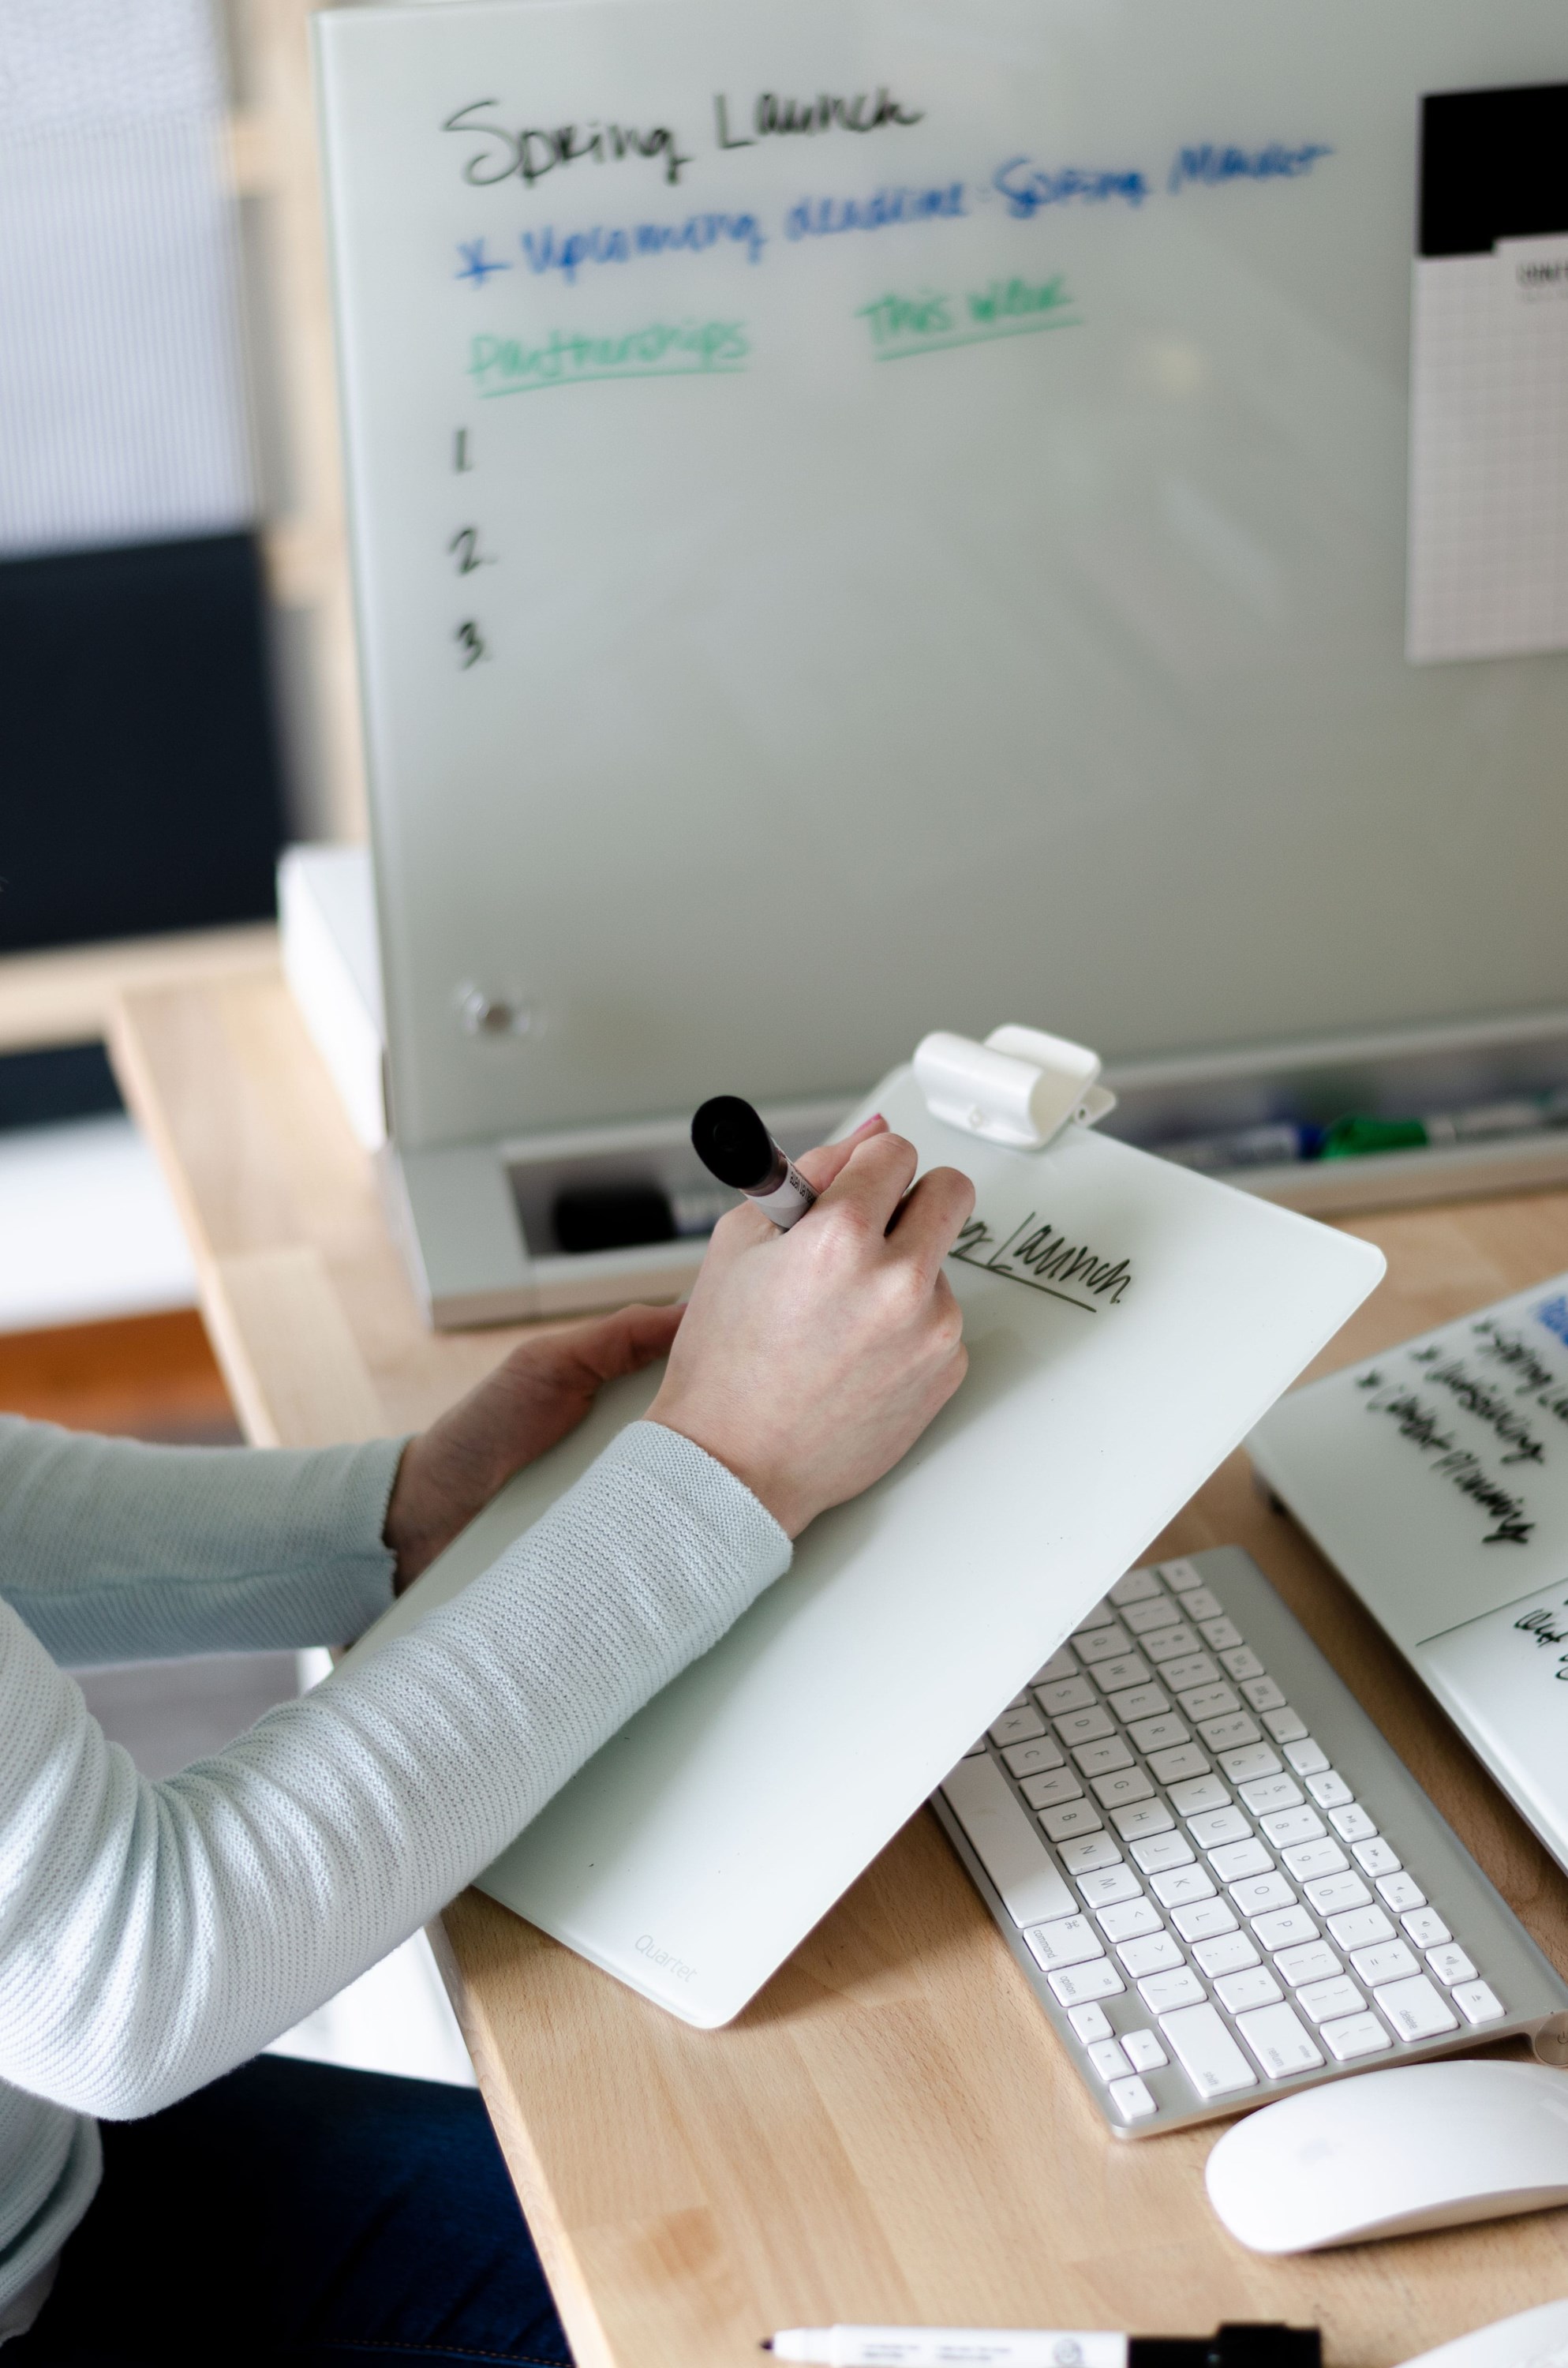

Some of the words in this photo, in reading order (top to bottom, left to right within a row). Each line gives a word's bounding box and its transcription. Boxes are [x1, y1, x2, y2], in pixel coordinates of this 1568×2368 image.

[443, 99, 694, 188] Spring
[713, 85, 925, 151] Launch
[520, 210, 765, 287] Upcoming
[854, 285, 953, 345] This
[988, 1210, 1132, 1304] Launch
[1110, 1665, 1126, 1675] W
[1094, 1749, 1110, 1759] F
[1132, 1812, 1149, 1821] H
[1211, 1819, 1227, 1828] U
[1080, 1845, 1096, 1854] N
[1098, 1879, 1117, 1889] M
[1173, 1879, 1190, 1887] K
[1032, 1929, 1057, 1959] command
[634, 1935, 697, 1983] Quartet
[1059, 1975, 1076, 1995] option
[1398, 2010, 1419, 2030] delete
[1267, 2048, 1284, 2067] return
[1298, 2044, 1312, 2059] enter
[1203, 2072, 1218, 2085] shift
